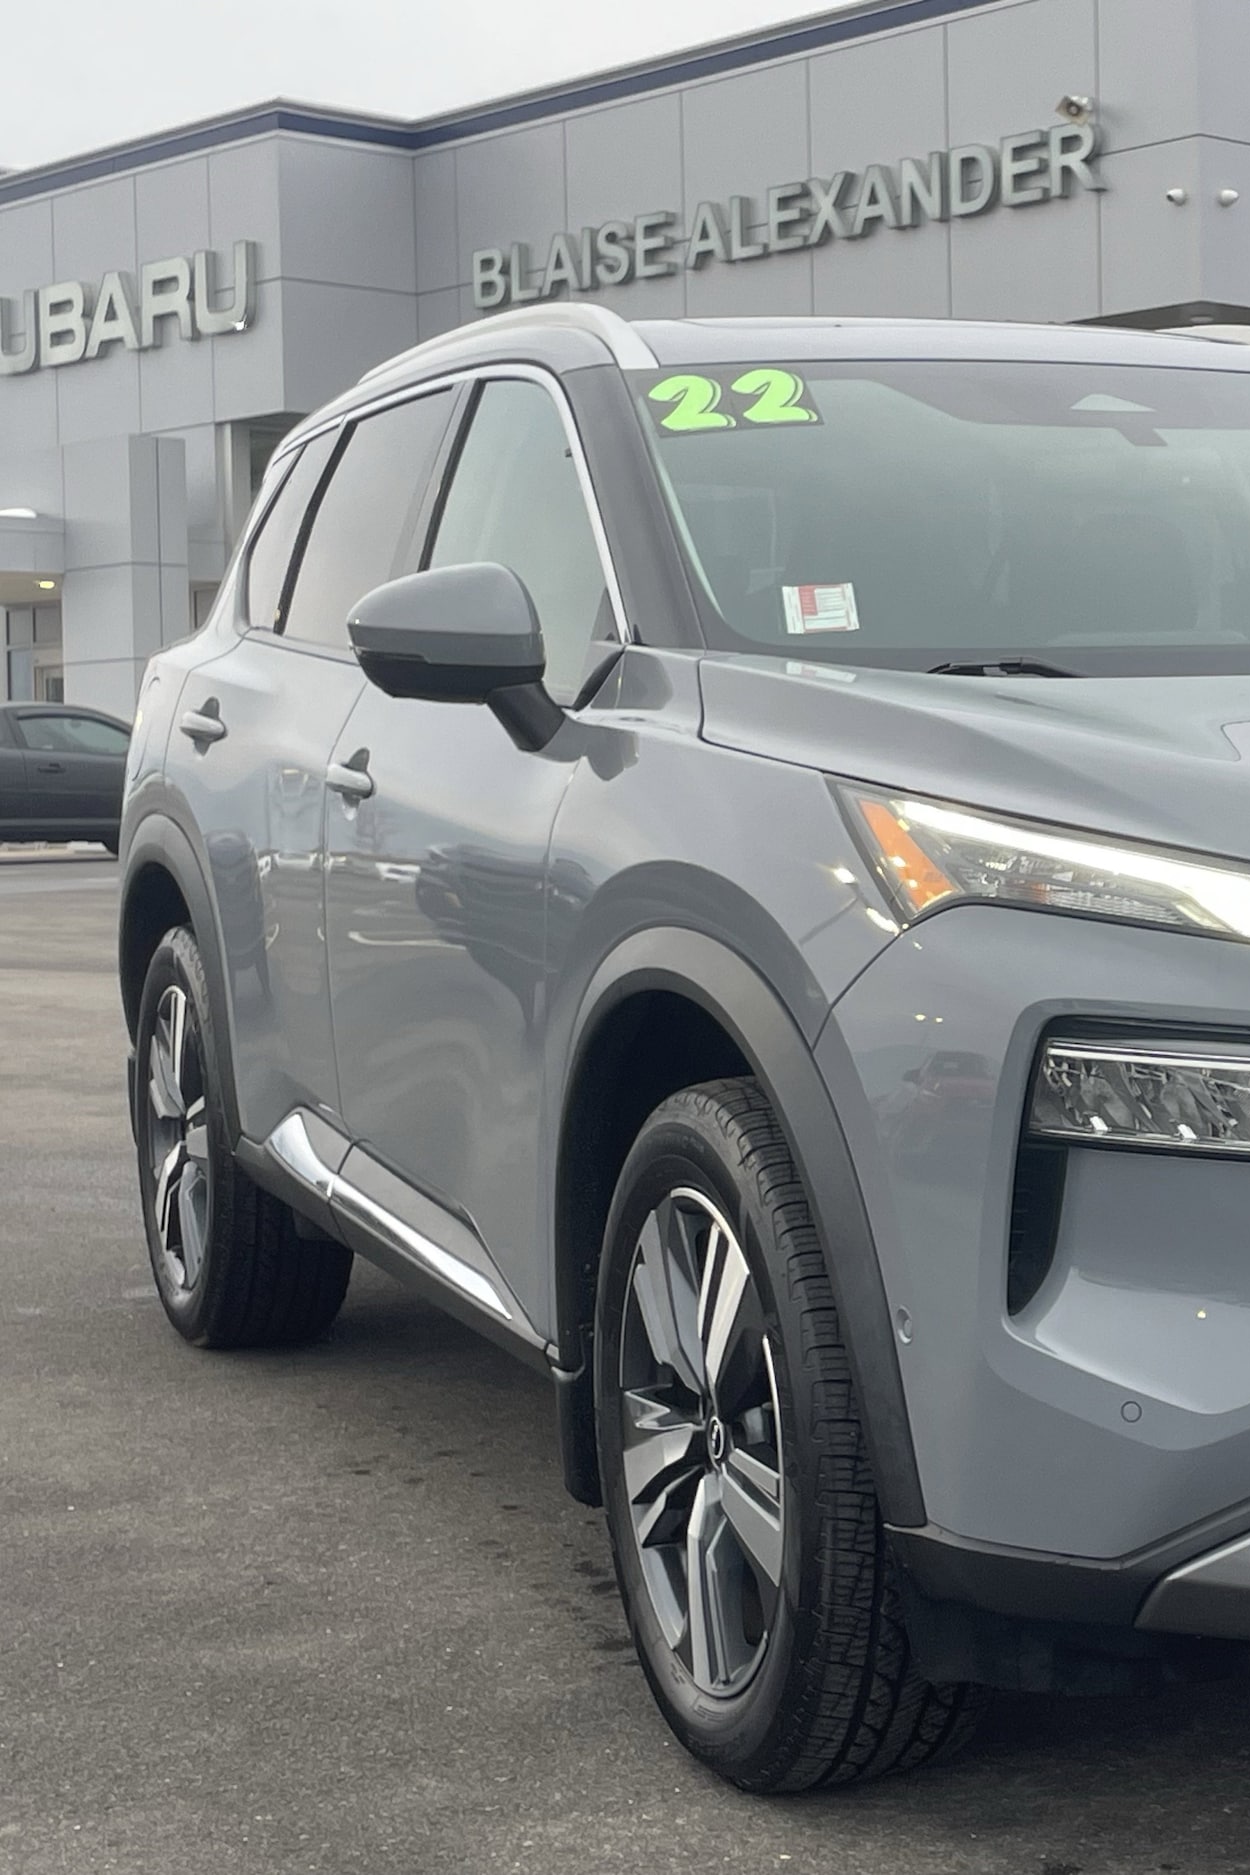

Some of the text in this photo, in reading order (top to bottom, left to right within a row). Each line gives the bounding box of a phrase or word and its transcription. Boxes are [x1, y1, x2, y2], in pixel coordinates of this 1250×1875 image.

[472, 123, 1106, 309] BLAISE ALEXANDER
[648, 368, 818, 431] 22
